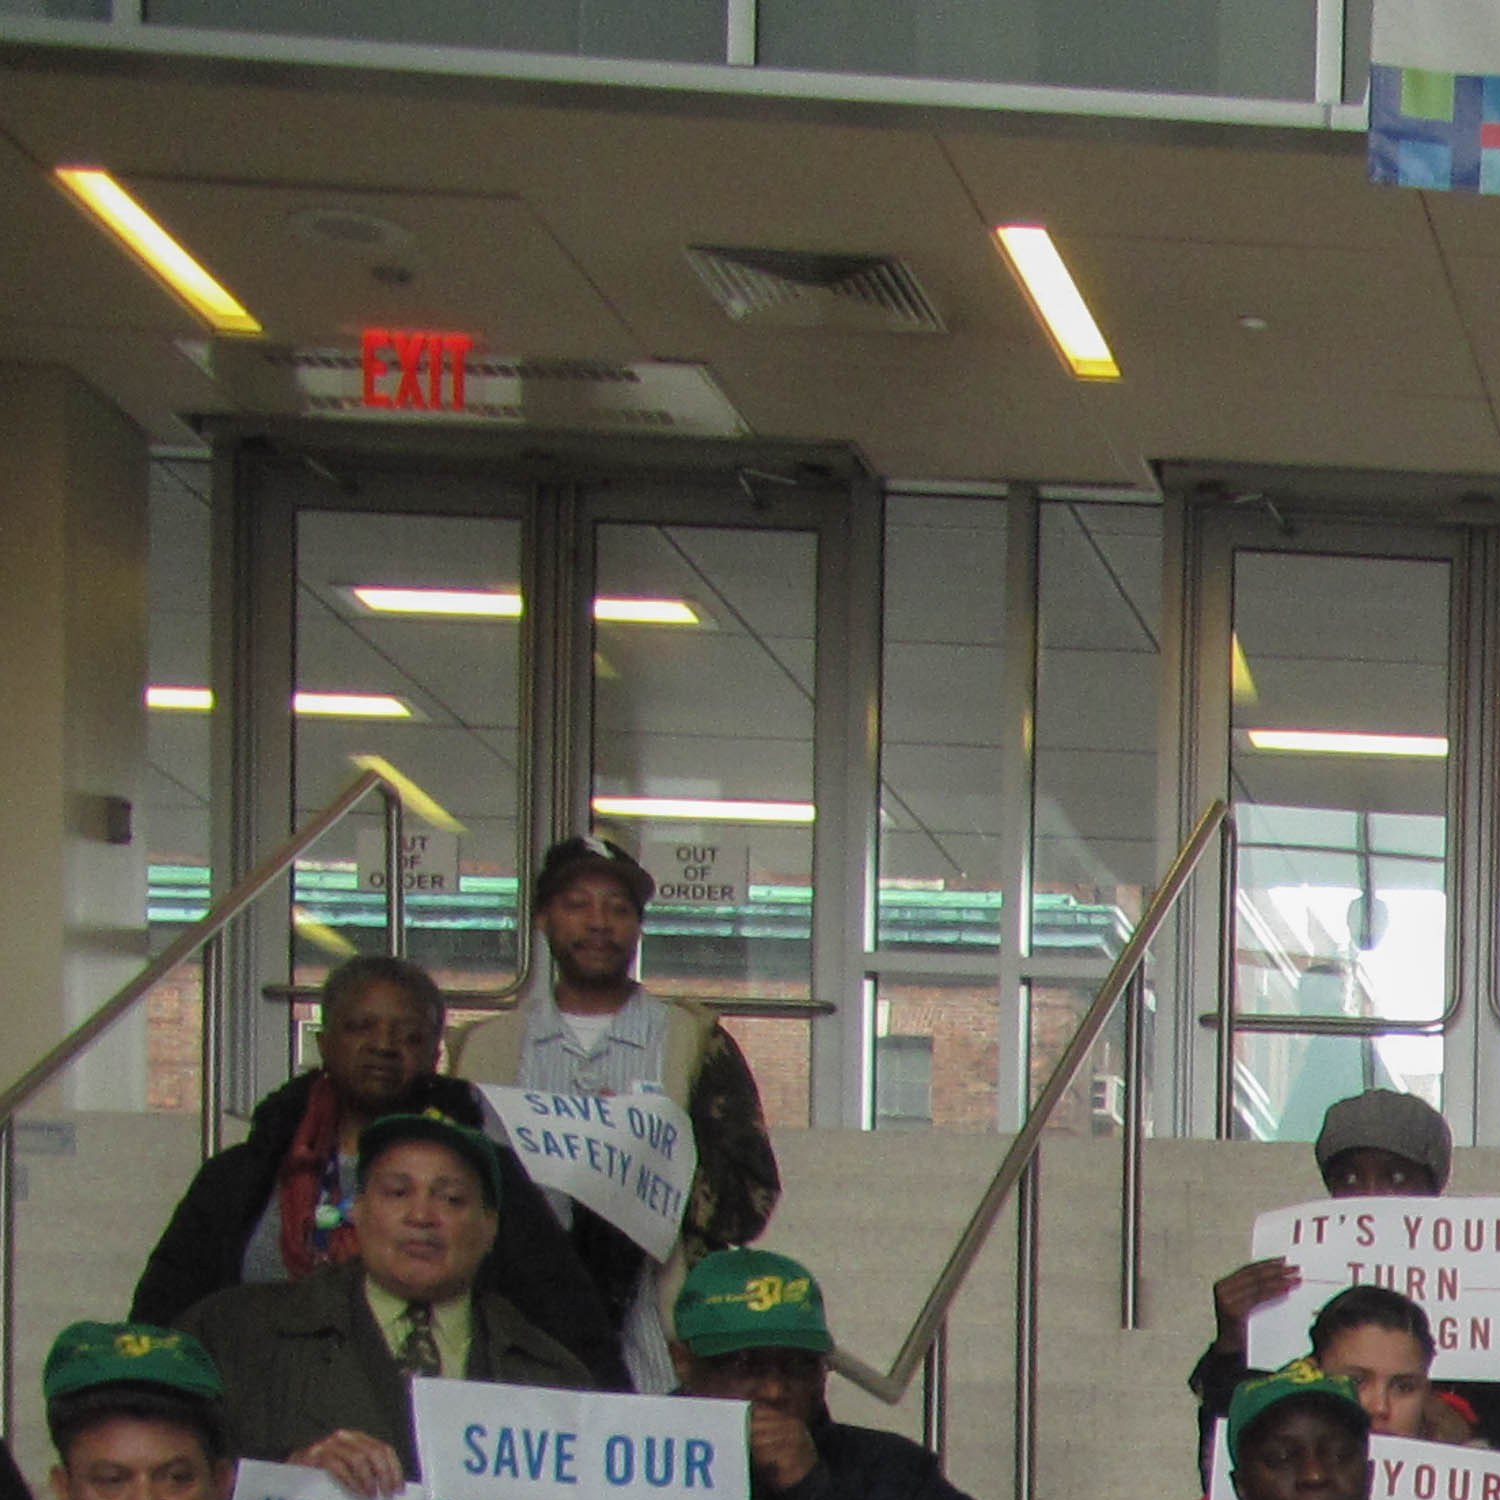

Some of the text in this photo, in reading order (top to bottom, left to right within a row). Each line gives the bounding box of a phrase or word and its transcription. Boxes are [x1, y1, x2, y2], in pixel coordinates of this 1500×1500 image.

[364, 329, 472, 408] EXIT
[676, 847, 719, 863] OUT
[370, 873, 444, 889] ODER
[684, 866, 712, 880] OF
[660, 884, 735, 901] ORDER
[524, 1094, 678, 1160] SAVE OUR
[515, 1127, 682, 1222] SAFETY NET!
[1292, 1214, 1376, 1246] IT'S
[1432, 1317, 1491, 1350] GN
[464, 1423, 714, 1488] SAVE OUR
